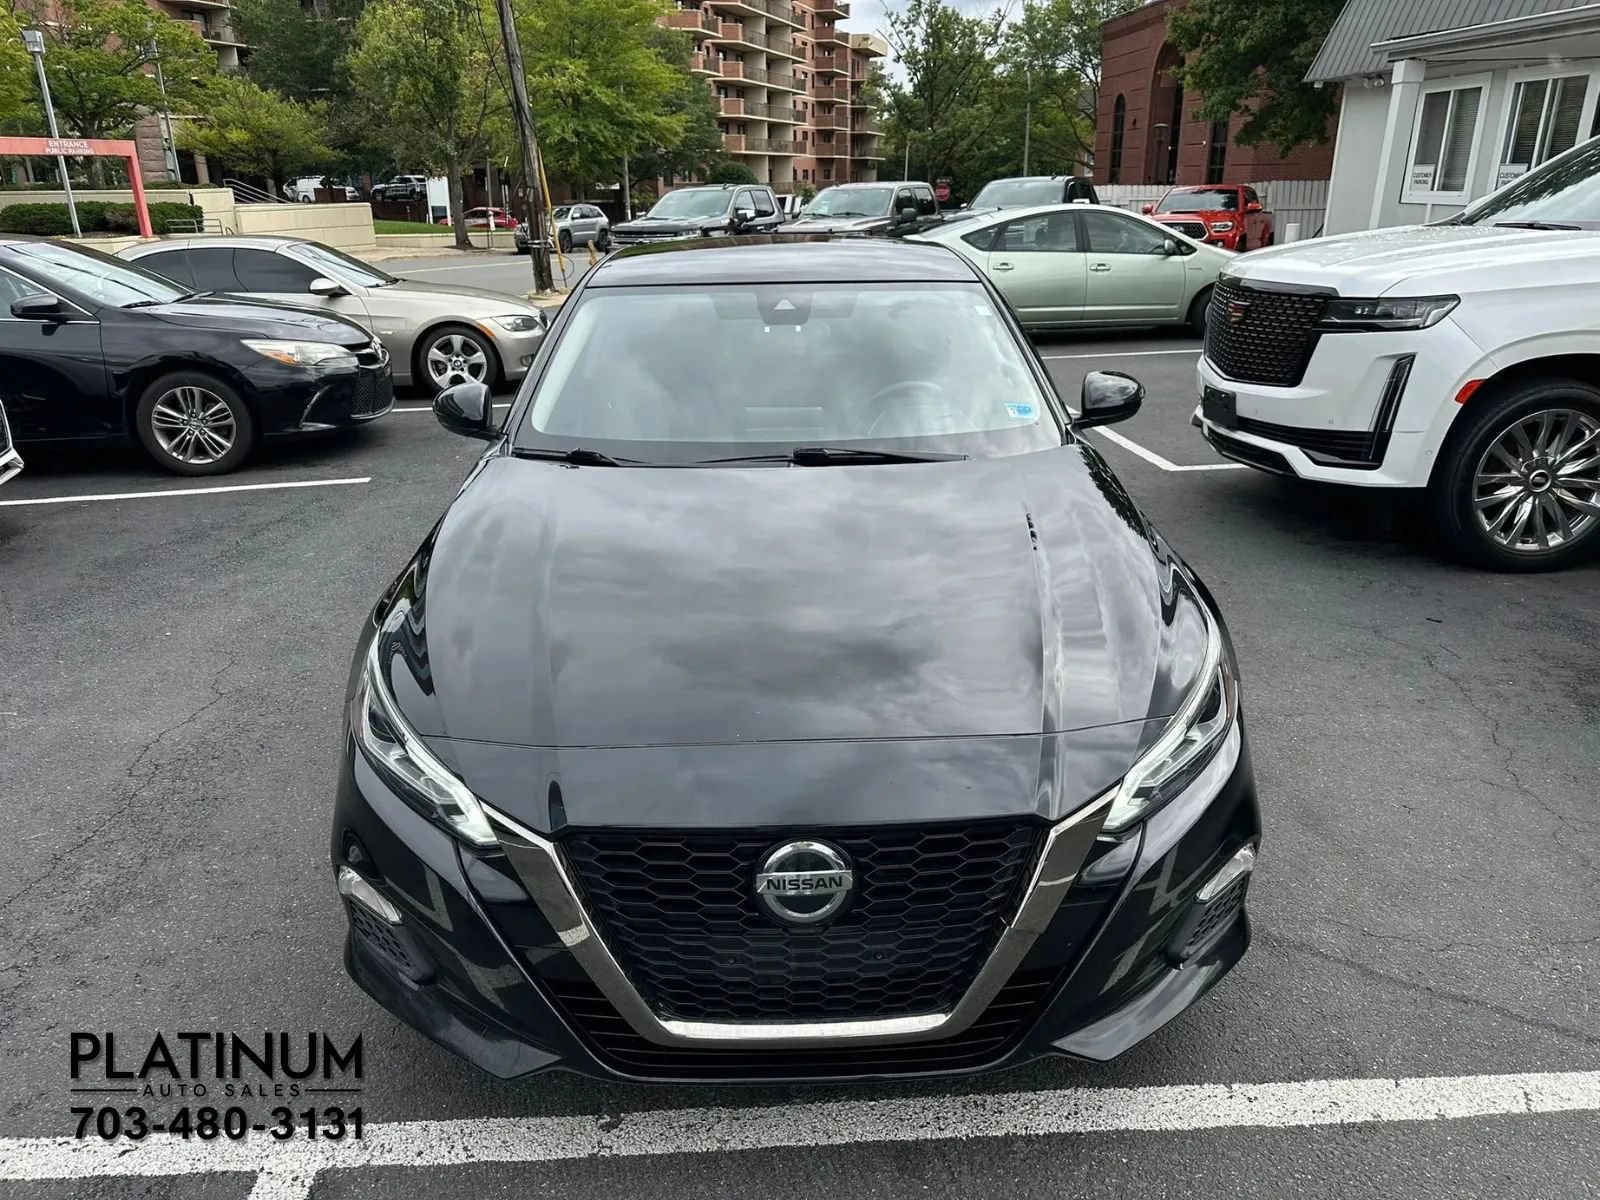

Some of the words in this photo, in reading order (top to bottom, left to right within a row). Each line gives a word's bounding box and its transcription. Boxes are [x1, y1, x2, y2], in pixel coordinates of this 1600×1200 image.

[48, 140, 89, 148] ENTRANCE
[936, 188, 950, 196] STOP
[766, 876, 843, 891] NISSAN
